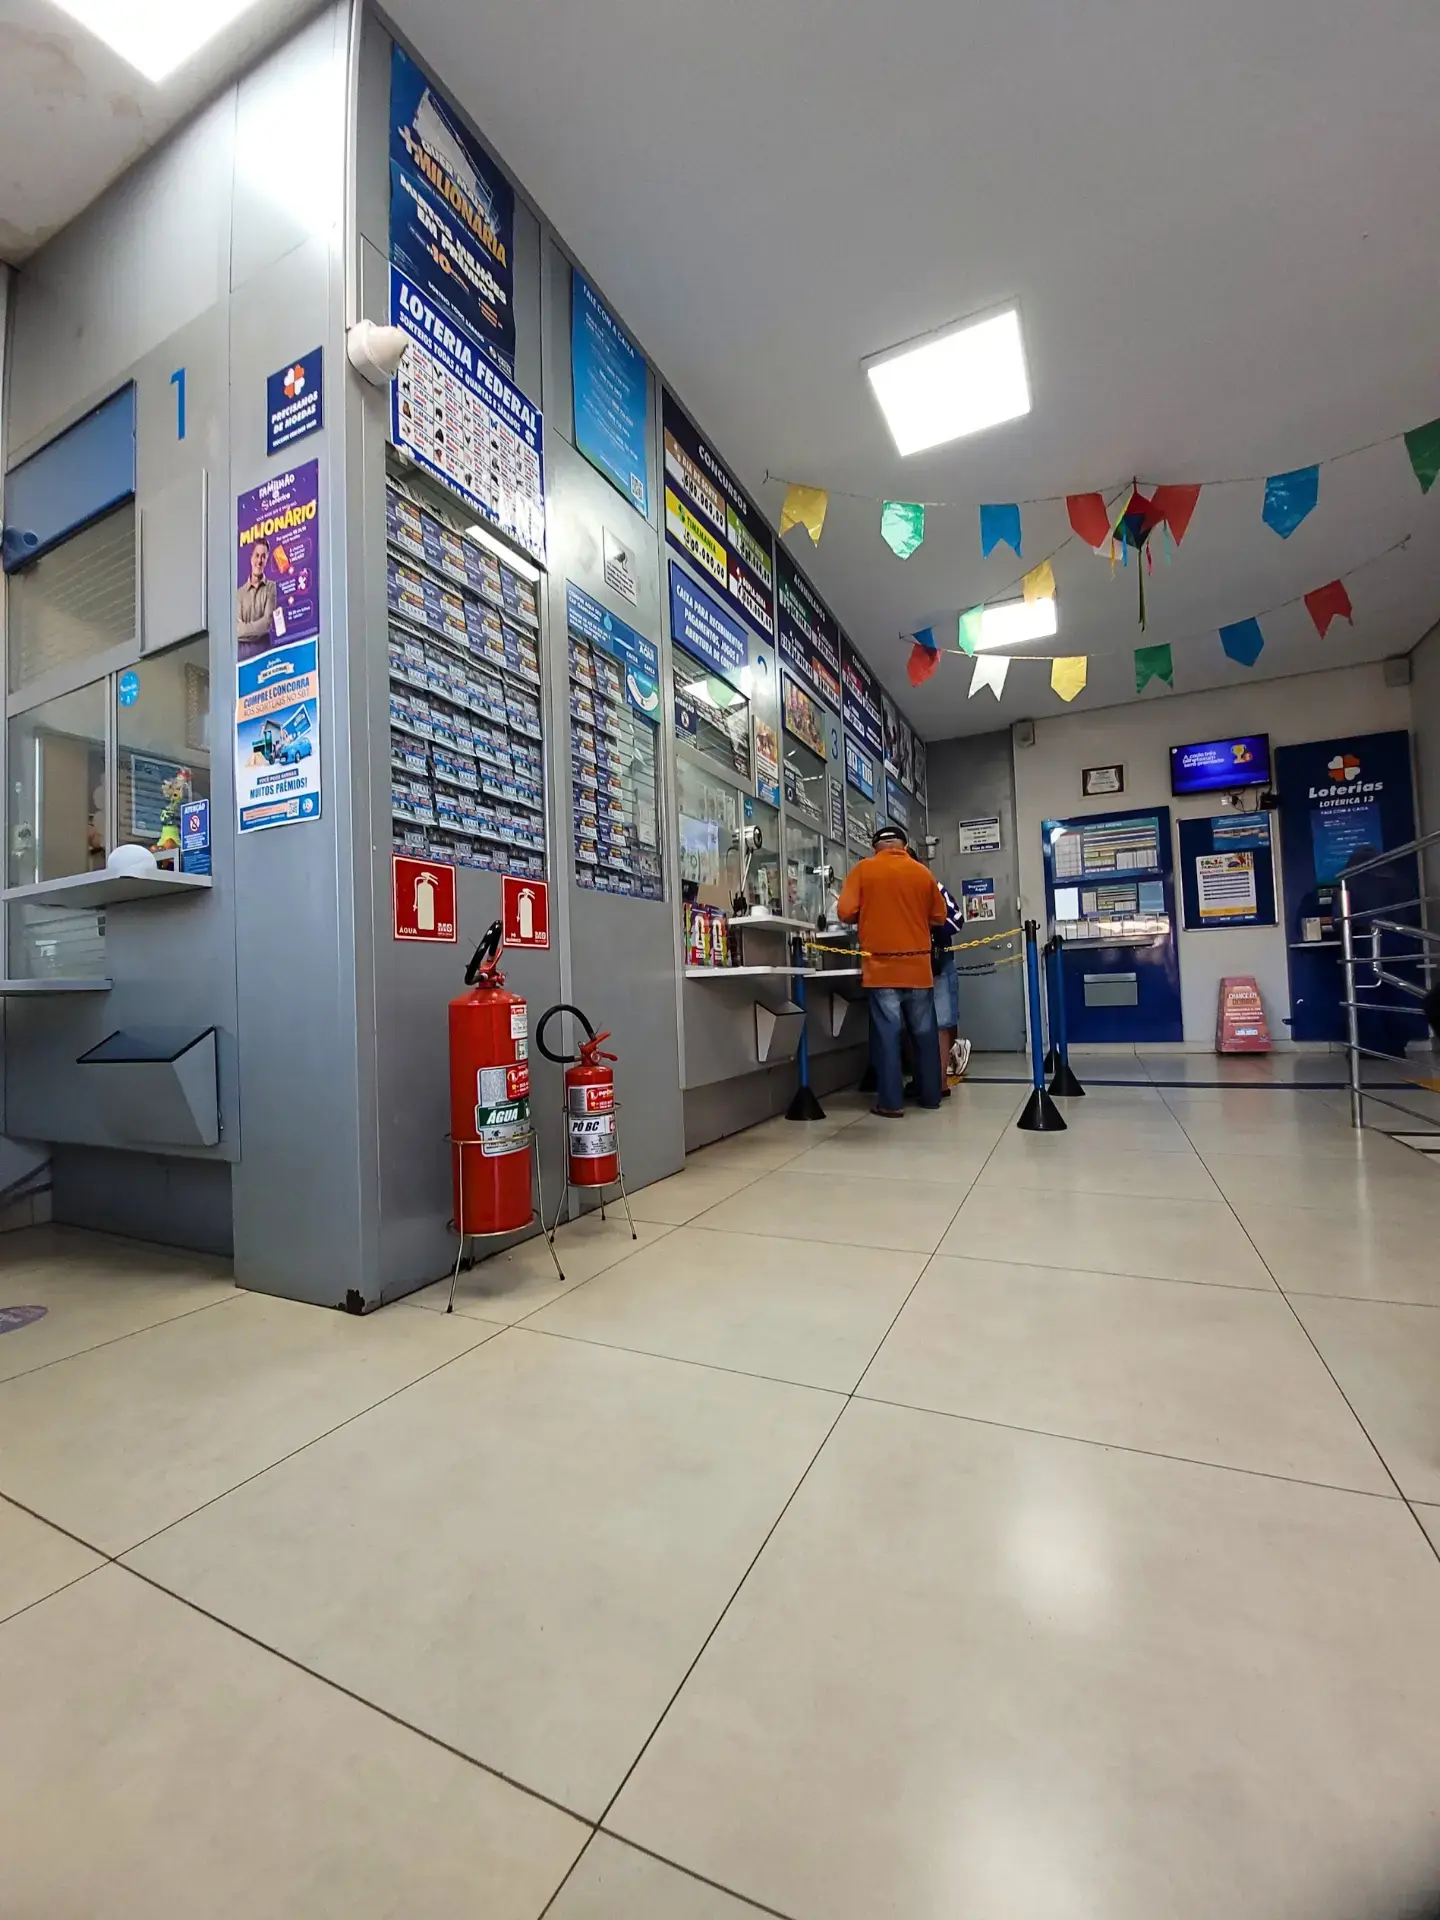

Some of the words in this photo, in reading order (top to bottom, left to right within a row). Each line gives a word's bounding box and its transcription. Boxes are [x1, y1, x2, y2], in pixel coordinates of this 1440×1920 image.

[421, 140, 453, 178] QUER
[400, 173, 453, 241] MUITOS
[456, 237, 508, 306] MILHÕES
[417, 205, 438, 241] EM
[441, 233, 496, 305] PRÊMIOS
[583, 285, 597, 309] FALE
[597, 304, 612, 329] COM
[617, 332, 635, 359] CAIXA
[399, 283, 472, 372] LOTERIA
[476, 359, 537, 434] FEDERAL
[399, 311, 432, 350] SORTEIOS
[433, 343, 455, 368] TODAS
[454, 365, 464, 379] AS
[465, 372, 492, 406] QUARTAS
[169, 367, 186, 441] 1
[271, 390, 319, 424] PRECISAMOS
[273, 420, 284, 435] DE
[284, 404, 317, 429] MOEDAS
[698, 445, 747, 515] CONCURSOS
[239, 499, 317, 548] MILIONÁRIO
[687, 516, 717, 554] TIMEMANIA
[676, 584, 693, 609] CAIXA
[693, 601, 709, 621] PARA
[709, 614, 744, 655] RECEBIMENTOS,
[684, 607, 721, 648] PAGAMENTOS,
[720, 639, 736, 661] JOGOS
[684, 625, 713, 657] ABERTURA
[713, 648, 720, 662] DE
[244, 690, 270, 709] COMPRE
[272, 676, 310, 698] CONCORRA
[286, 693, 297, 703] NO
[298, 687, 309, 698] SBT
[832, 728, 838, 759] 3
[250, 784, 275, 800] MUITOS
[275, 776, 308, 794] PRÊMIOS!
[1308, 780, 1384, 799] Loterias
[1319, 796, 1361, 808] LOTÉRICA
[1362, 795, 1374, 804] 13
[184, 802, 206, 815] ATENÇÃO
[399, 926, 417, 935] ÁGUA
[486, 1107, 519, 1125] ÁGUA
[572, 1119, 584, 1132] PÓ
[584, 1120, 600, 1132] BC
